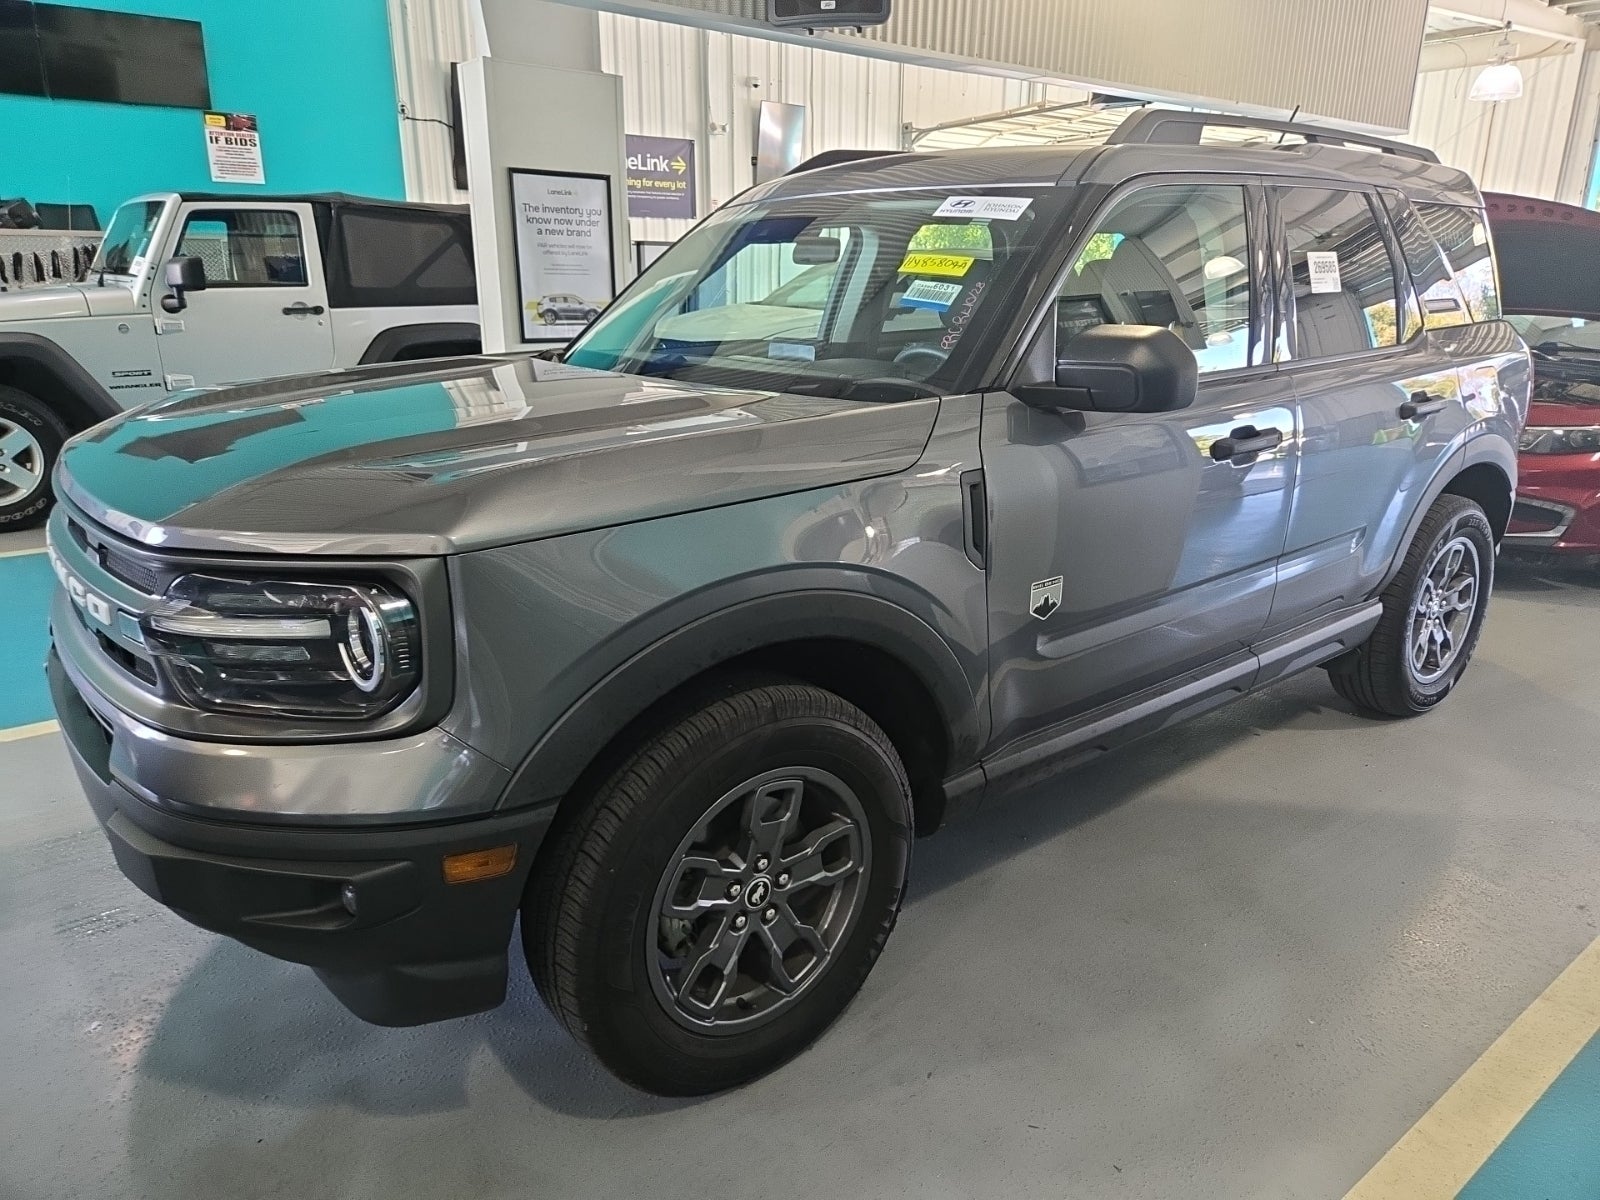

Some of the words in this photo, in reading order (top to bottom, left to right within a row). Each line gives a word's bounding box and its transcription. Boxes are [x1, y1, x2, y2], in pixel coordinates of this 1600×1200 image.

[209, 135, 221, 145] IF
[224, 136, 257, 147] BIDS
[642, 178, 653, 187] for
[654, 181, 676, 190] every
[676, 180, 687, 189] lot
[522, 202, 540, 213] The
[541, 203, 583, 217] inventory
[585, 208, 602, 218] you
[526, 215, 552, 225] know
[553, 218, 573, 226] now
[575, 218, 601, 227] under
[536, 228, 543, 236] a
[545, 228, 564, 236] new
[566, 227, 592, 237] brand
